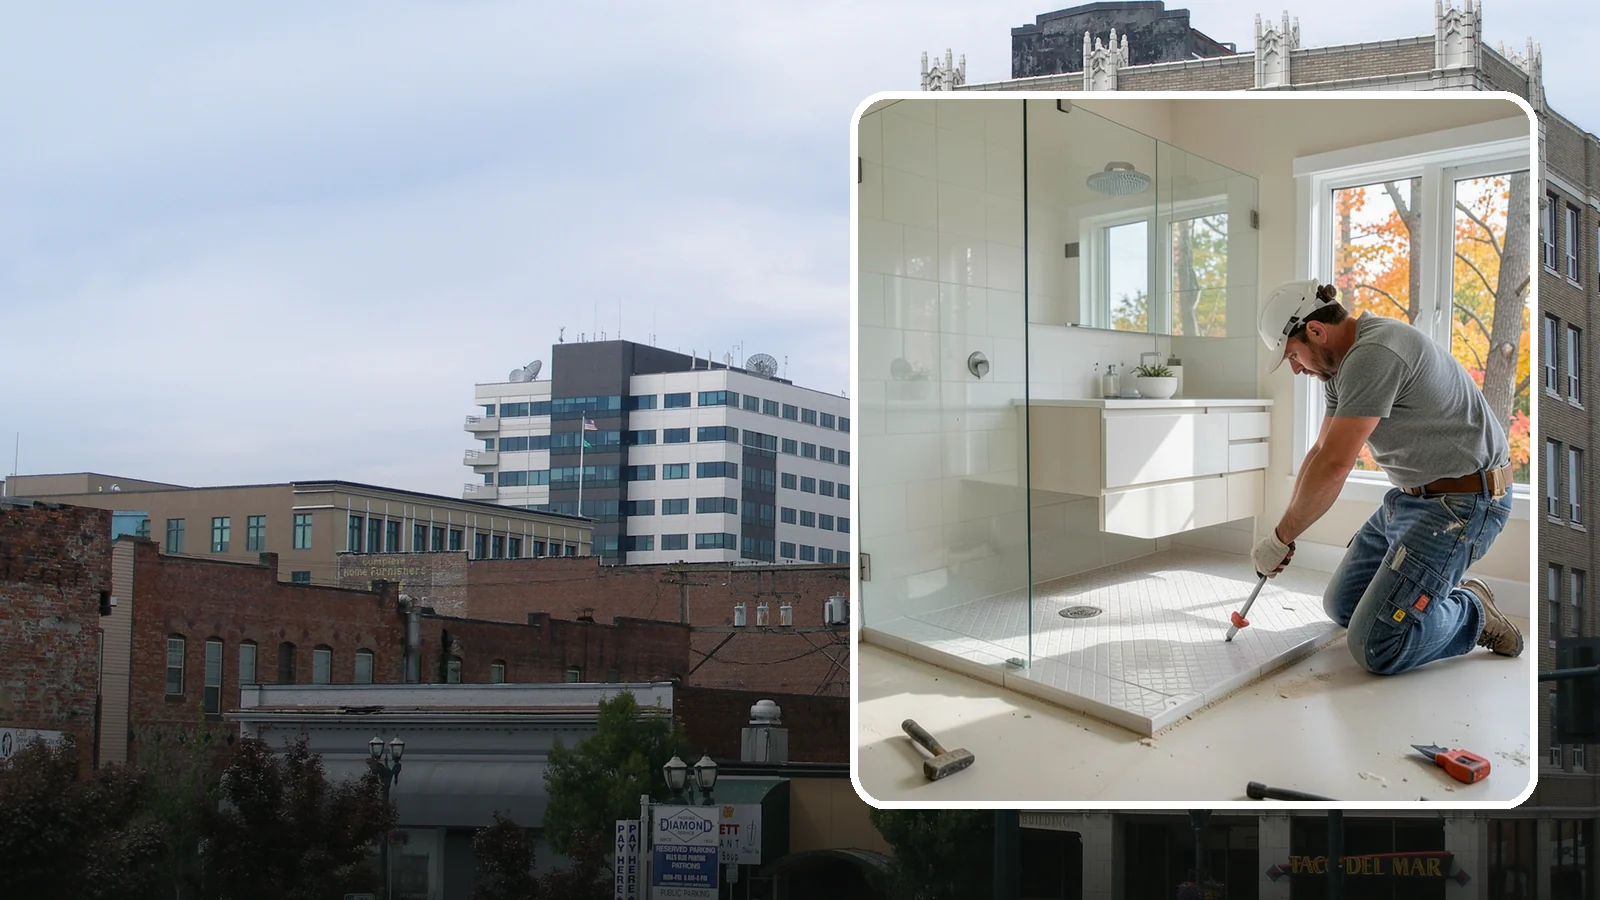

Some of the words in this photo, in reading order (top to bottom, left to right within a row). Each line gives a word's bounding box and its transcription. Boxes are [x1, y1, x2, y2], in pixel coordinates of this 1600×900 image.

[344, 568, 367, 577] Home
[370, 566, 428, 576] Furnishers
[660, 818, 713, 833] DIAMOND
[1022, 815, 1069, 828] BUILDING
[617, 825, 625, 852] PAY
[628, 825, 636, 852] PAY
[656, 845, 688, 853] RESERVED
[689, 846, 716, 854] PARKING
[722, 851, 739, 862] Soup
[671, 862, 701, 870] PATRONS
[1289, 855, 1330, 874] TAC
[1346, 857, 1385, 875] DEL
[1393, 857, 1442, 877] MAR
[616, 856, 625, 893] HERE
[627, 856, 636, 893] HERE
[660, 888, 682, 897] PUBLIC
[683, 889, 710, 898] PARKING
